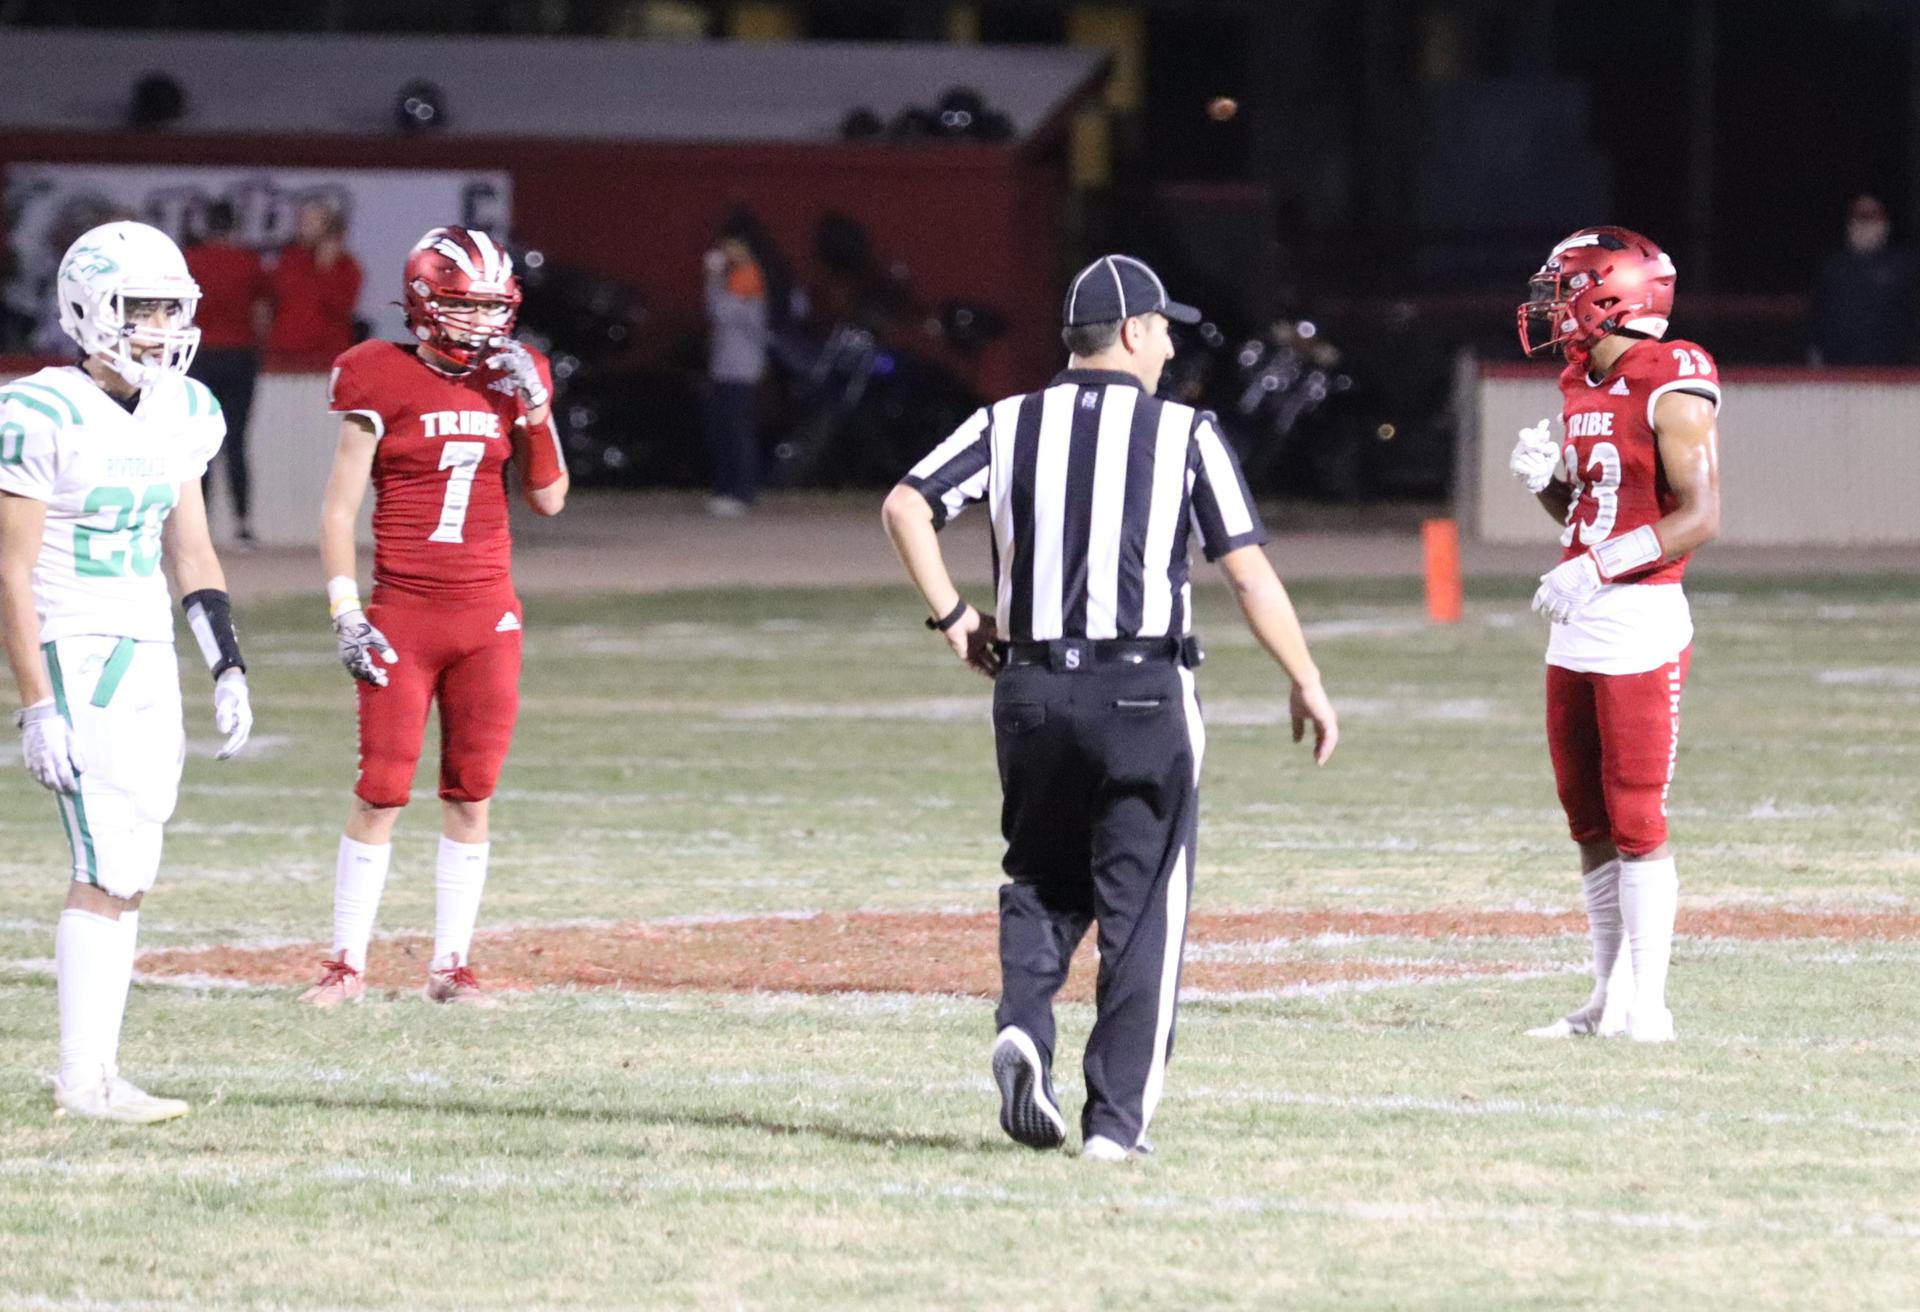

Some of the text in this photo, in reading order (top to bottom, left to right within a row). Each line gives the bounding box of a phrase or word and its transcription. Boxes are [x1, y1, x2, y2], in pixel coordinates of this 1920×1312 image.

[1673, 349, 1712, 376] 23
[420, 411, 500, 438] TRIBE
[428, 441, 486, 543] 7
[74, 484, 175, 577] 20
